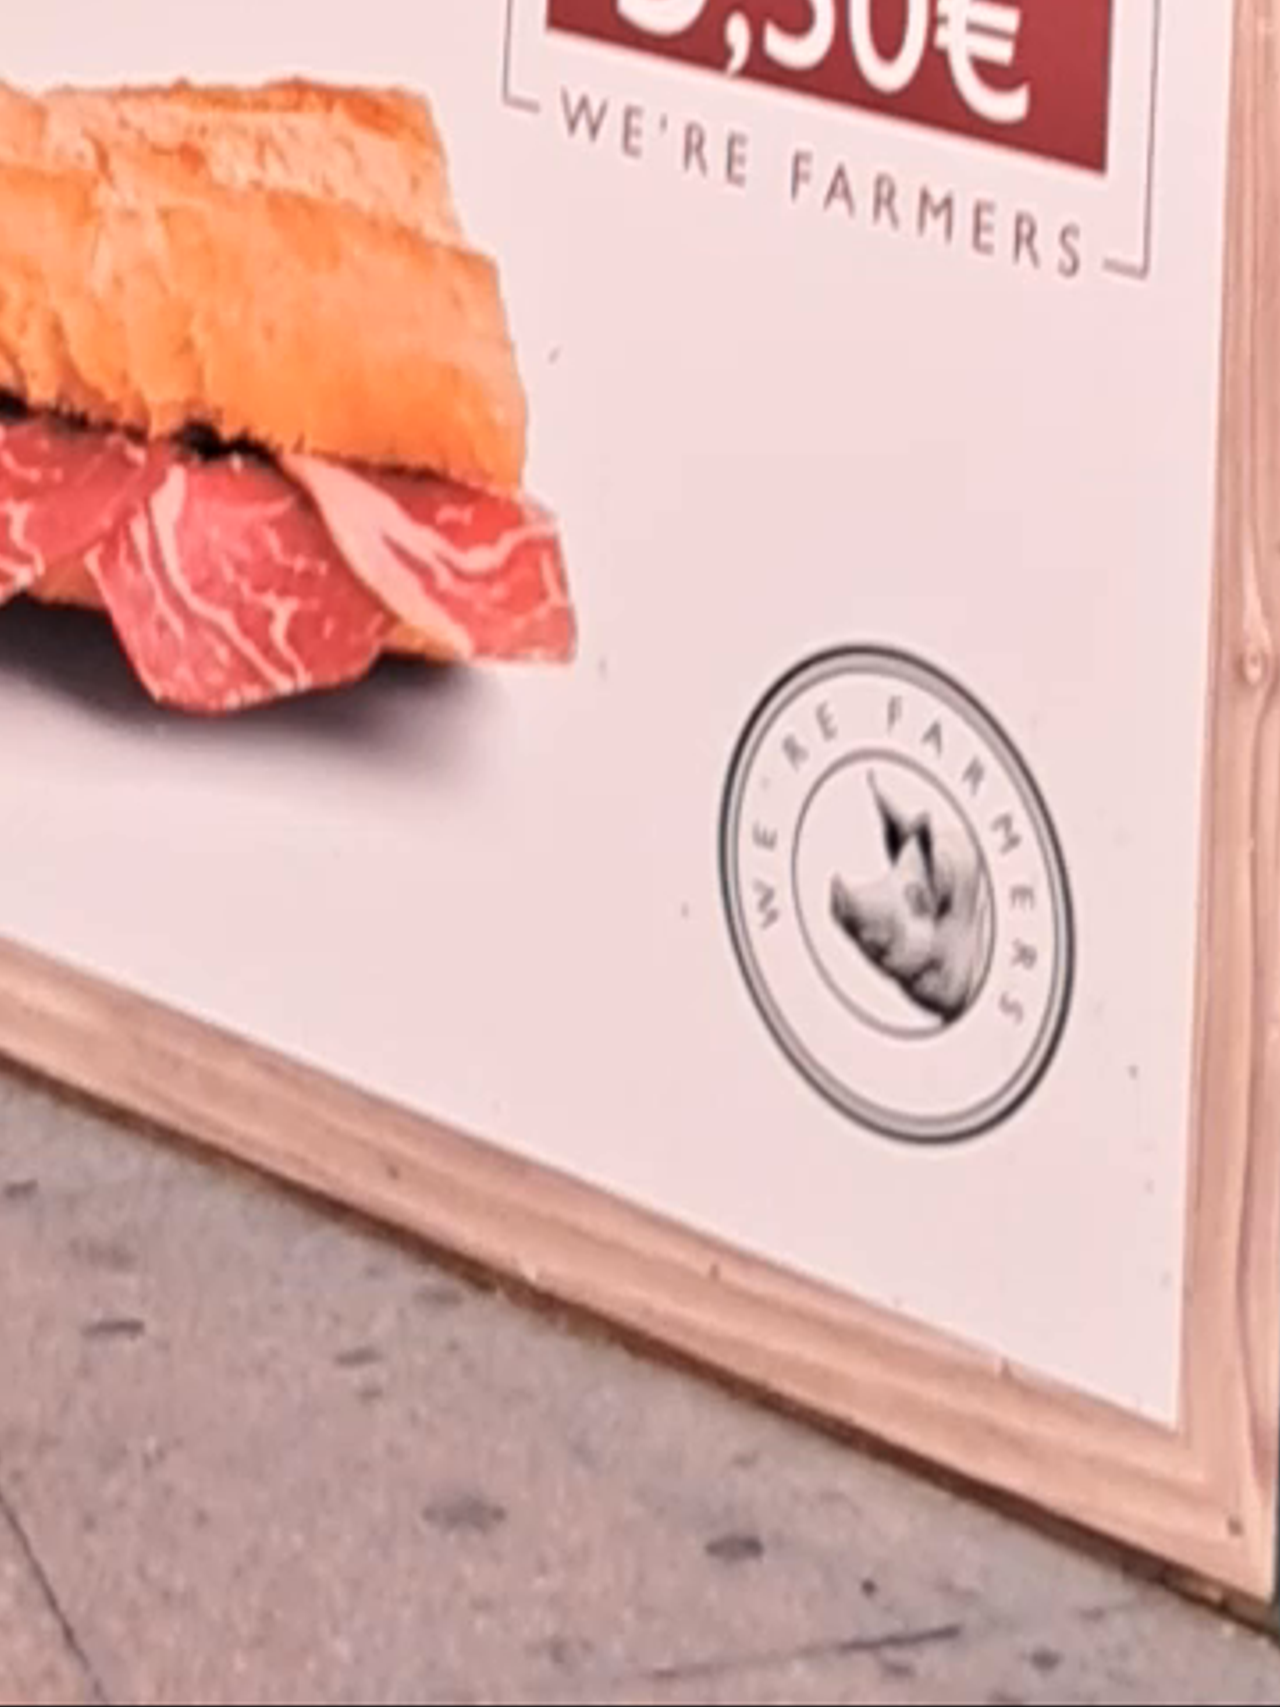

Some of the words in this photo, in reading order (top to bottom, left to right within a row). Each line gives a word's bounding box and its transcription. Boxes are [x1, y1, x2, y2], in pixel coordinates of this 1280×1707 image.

[560, 86, 748, 186] WE'RE
[789, 149, 1082, 280] FARMERS
[884, 694, 1038, 1026] FARMERS
